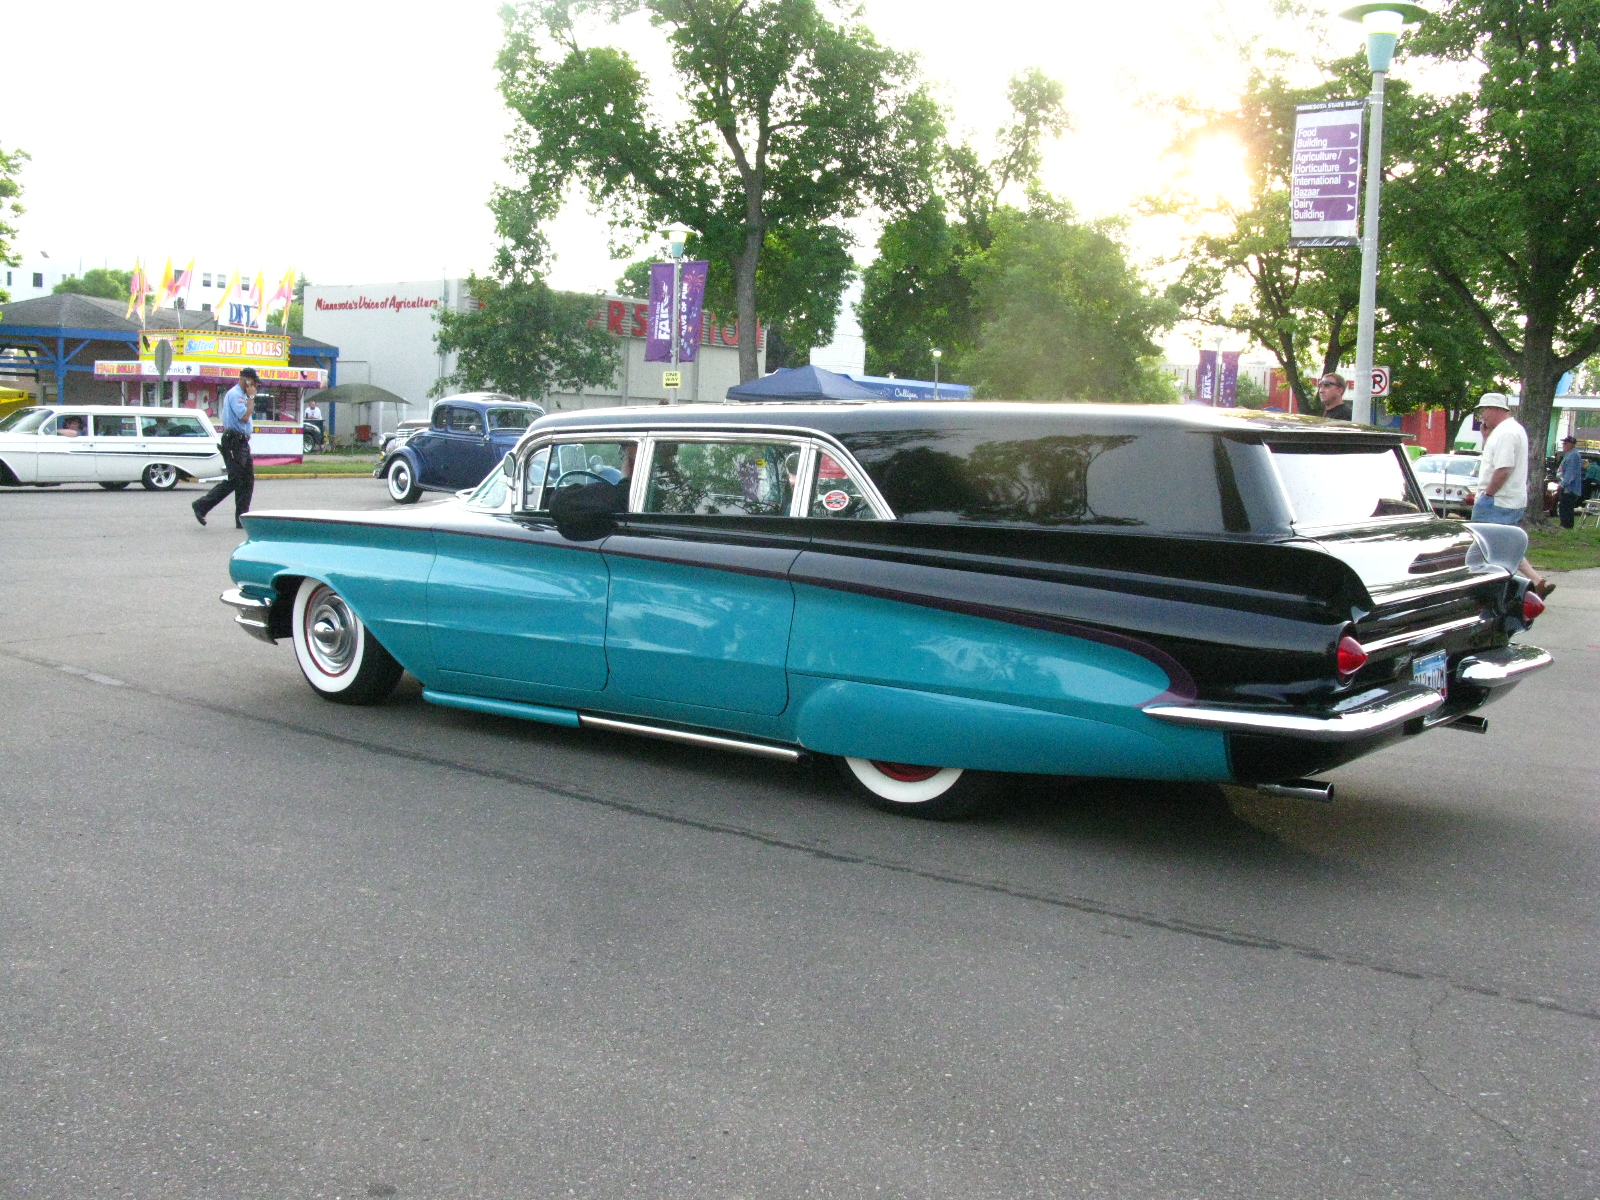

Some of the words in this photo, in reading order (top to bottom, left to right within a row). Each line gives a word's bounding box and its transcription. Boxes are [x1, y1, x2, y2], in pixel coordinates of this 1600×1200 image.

[1296, 103, 1326, 111] MINNESOTA
[1298, 127, 1316, 137] Food
[1297, 137, 1327, 148] Building
[1295, 163, 1339, 173] Horticulture
[1295, 175, 1341, 185] International
[1294, 187, 1320, 196] Bazaar
[1294, 199, 1313, 210] Dairy
[1294, 210, 1324, 220] Building
[316, 298, 357, 310] Minnesota's
[359, 296, 379, 309] Voice
[380, 298, 388, 309] of
[681, 302, 687, 312] OF
[658, 292, 670, 339] FAIR
[218, 338, 242, 354] NUT
[246, 341, 283, 357] ROLLS
